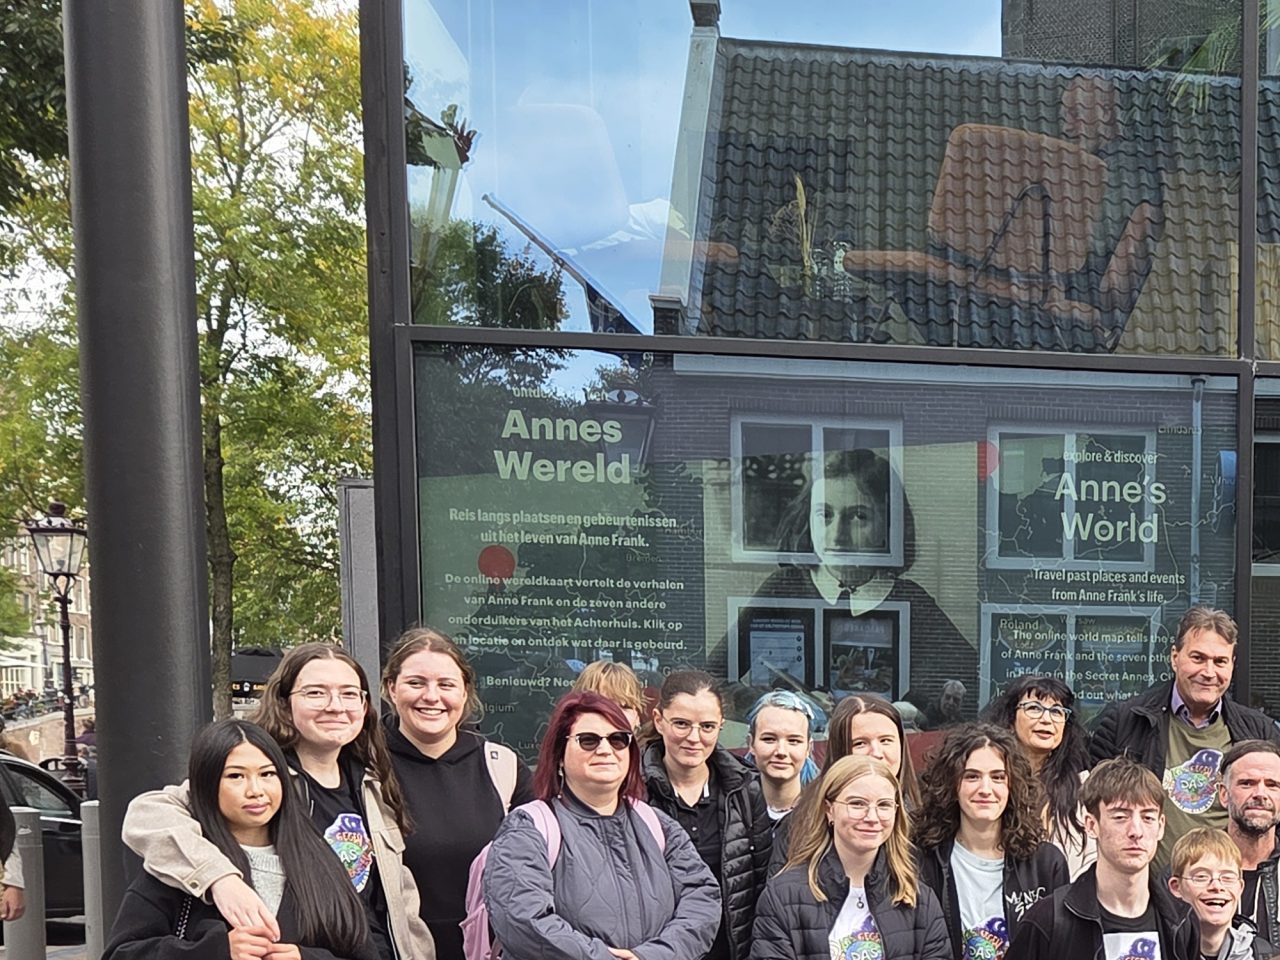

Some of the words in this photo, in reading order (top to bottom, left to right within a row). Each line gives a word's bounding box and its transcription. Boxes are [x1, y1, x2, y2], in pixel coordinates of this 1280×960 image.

[501, 409, 623, 443] Annes
[1063, 450, 1102, 463] explore
[1104, 451, 1112, 462] &
[1114, 451, 1158, 464] discover
[494, 450, 631, 484] Wereld
[1054, 472, 1167, 504] Anne's
[449, 508, 476, 521] Reis
[478, 509, 511, 524] langs
[512, 511, 565, 526] plaatsen
[567, 515, 582, 525] en
[1061, 512, 1159, 543] World
[481, 530, 497, 542] uit
[498, 531, 520, 543] het
[521, 532, 553, 544] leven
[556, 534, 577, 545] van
[579, 533, 610, 546] Anne
[612, 534, 650, 547] Frank.
[445, 574, 461, 584] De
[463, 575, 499, 585] online
[502, 575, 573, 587] wereldkaart
[576, 578, 614, 588] vertelt
[616, 578, 631, 588] de
[633, 580, 684, 590] verhalen
[1034, 568, 1065, 581] Travel
[1067, 571, 1091, 583] past
[1093, 570, 1127, 585] places
[1129, 572, 1148, 583] and
[1150, 573, 1186, 584] events
[464, 597, 486, 606] van
[487, 596, 518, 606] Anne
[521, 596, 553, 607] Frank
[556, 599, 570, 607] en
[572, 598, 588, 608] de
[589, 600, 623, 609] zeven
[625, 598, 666, 609] andere
[1051, 588, 1077, 600] from
[1079, 590, 1107, 601] Anne
[1108, 590, 1146, 602] Frank's
[448, 615, 527, 627] onderduikers
[529, 618, 550, 627] van
[552, 616, 572, 627] het
[574, 618, 641, 630] Achterhuis.
[644, 619, 667, 630] Klik
[668, 622, 683, 633] op
[469, 635, 509, 647] locatie
[511, 638, 526, 647] en
[528, 636, 569, 648] ontdek
[571, 638, 593, 648] wat
[594, 638, 621, 649] daar
[623, 639, 633, 649] is
[634, 639, 688, 652] gebeurd.
[1013, 629, 1032, 641] The
[1034, 630, 1067, 641] online
[1069, 632, 1099, 642] world
[1101, 635, 1124, 644] map
[1126, 634, 1149, 643] tells
[1001, 651, 1012, 659] of
[1014, 650, 1042, 660] Anne
[1044, 651, 1073, 661] Frank
[1075, 652, 1095, 661] and
[1097, 652, 1115, 662] the
[1116, 653, 1147, 663] seven
[486, 675, 551, 687] Benieuwd?
[1066, 669, 1083, 680] the
[1085, 671, 1120, 681] Secret
[1121, 671, 1158, 682] Annex.
[1086, 691, 1104, 700] out
[1180, 780, 1205, 790] DAS
[340, 849, 359, 864] AS
